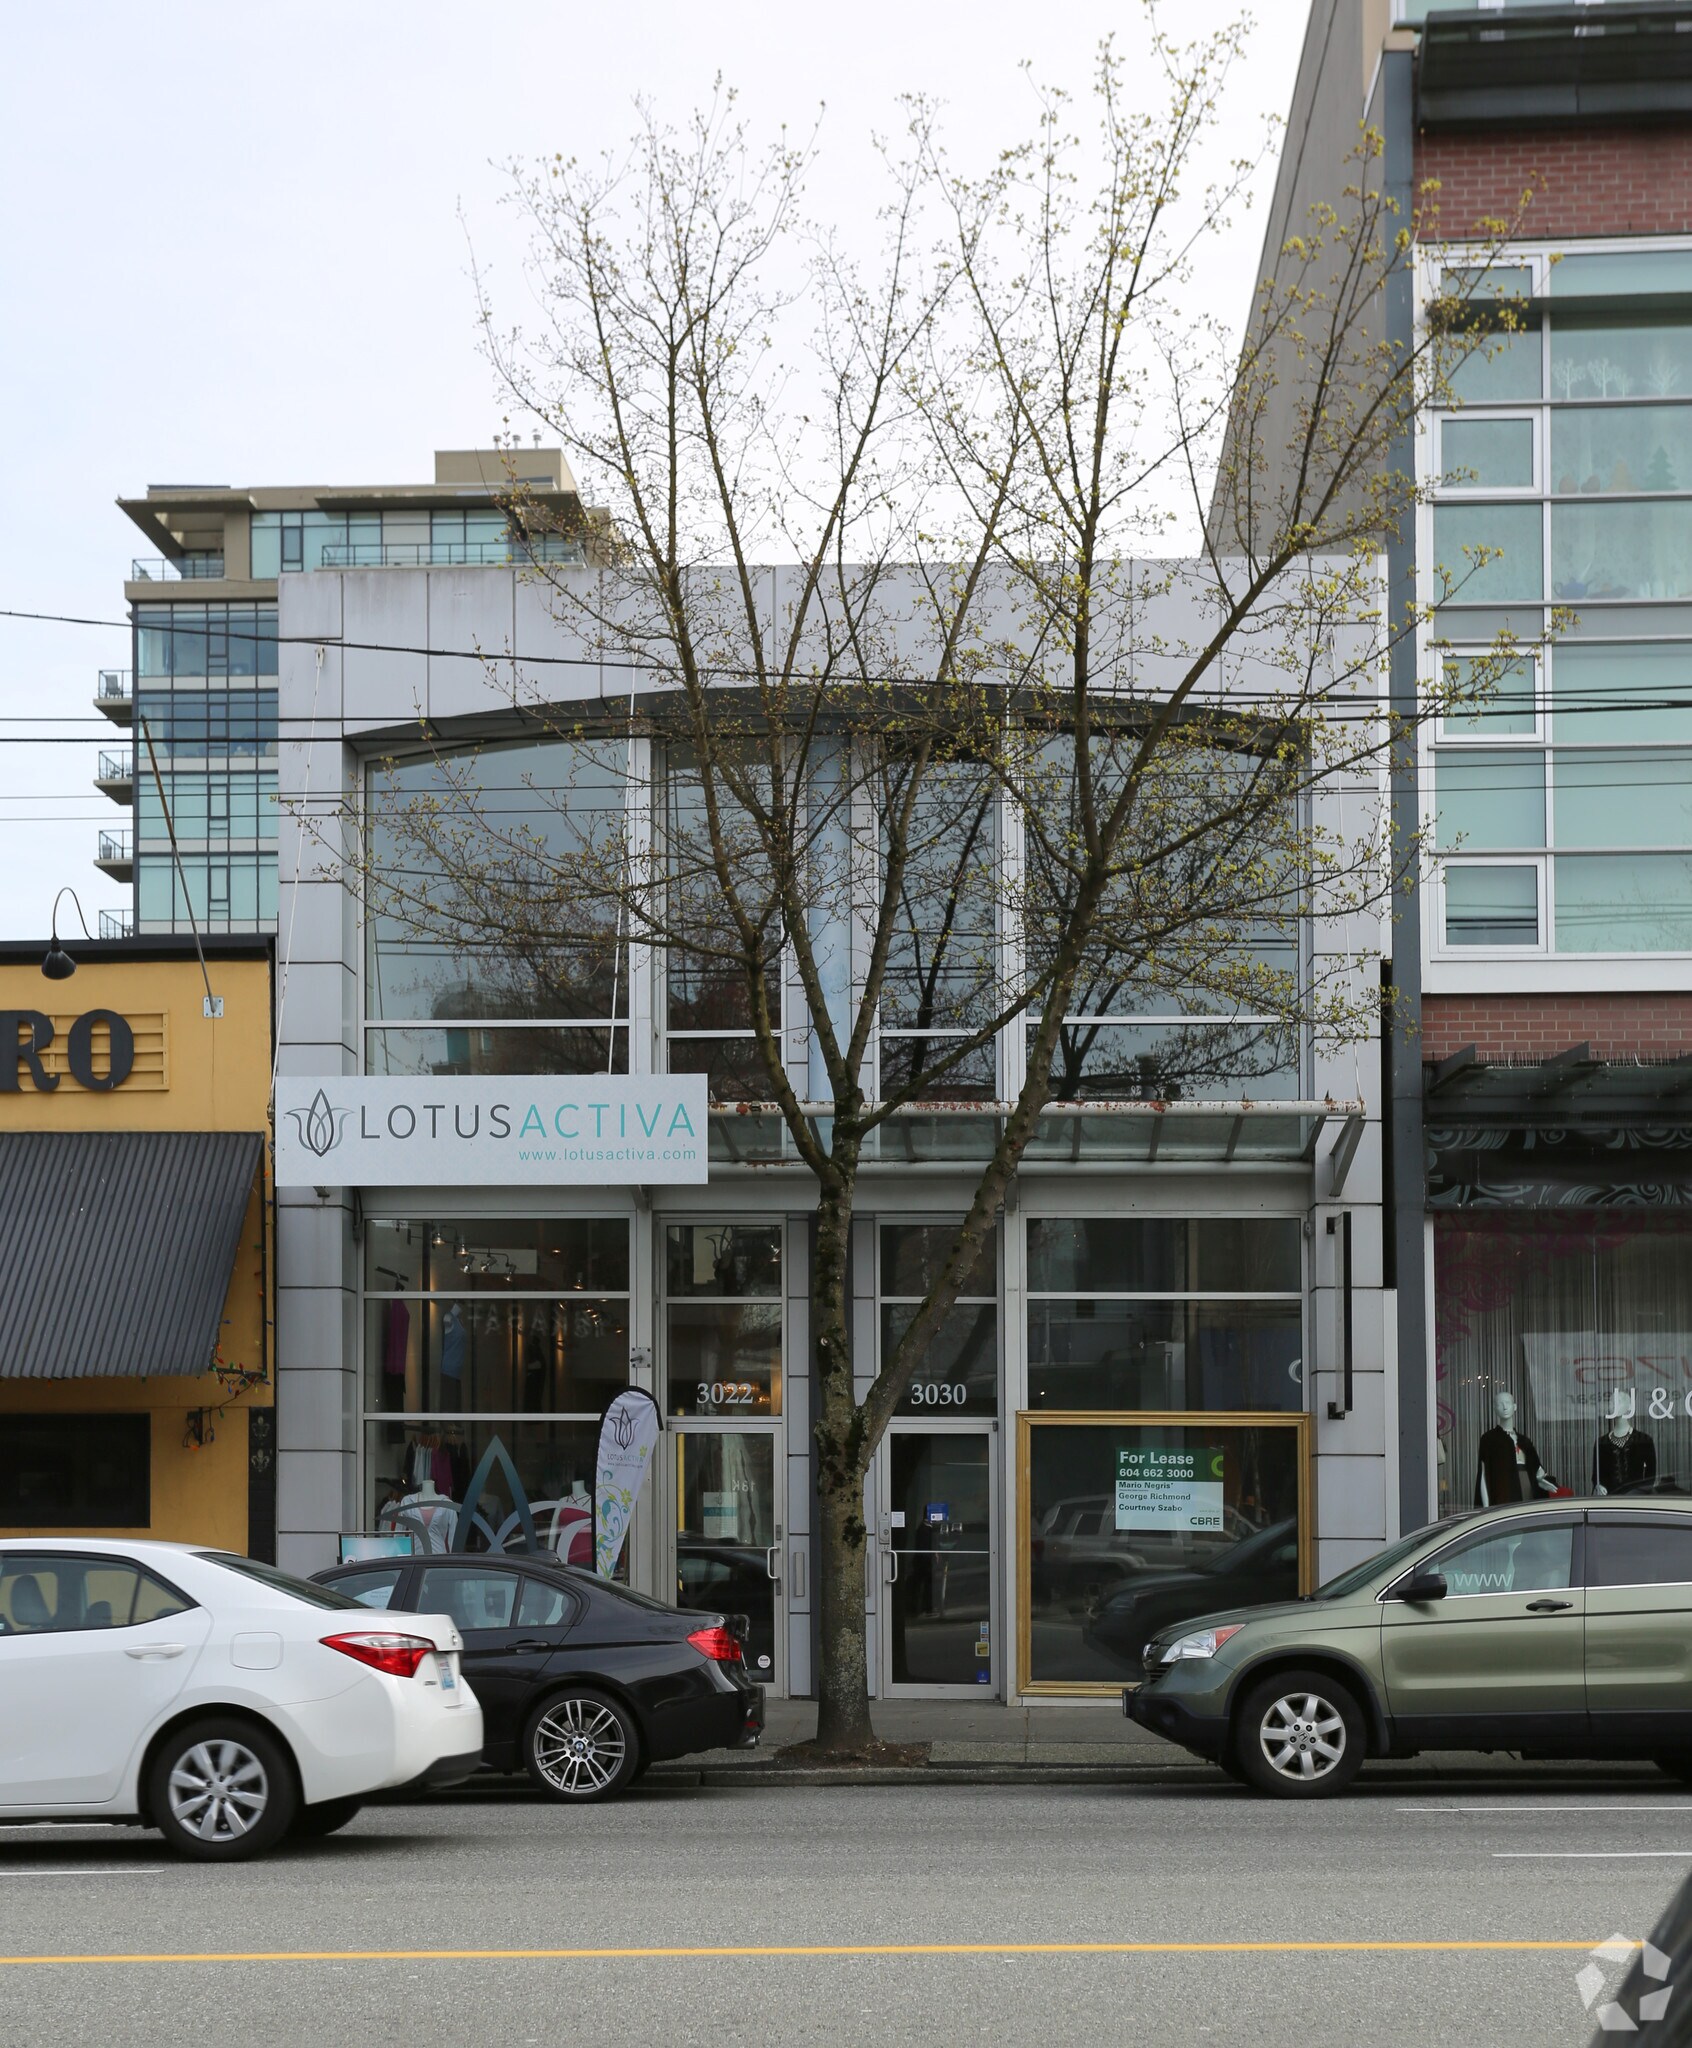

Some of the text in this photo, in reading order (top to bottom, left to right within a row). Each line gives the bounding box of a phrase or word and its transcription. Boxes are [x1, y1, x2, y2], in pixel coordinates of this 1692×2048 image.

[519, 1147, 696, 1161] www.lotusactiva.com
[696, 1382, 754, 1404] 3022
[911, 1383, 967, 1405] 3030
[1605, 1388, 1636, 1419] JJ
[1649, 1387, 1674, 1419] &
[1120, 1451, 1194, 1465] For Lease
[1119, 1468, 1194, 1478] 604 662 3000
[1118, 1493, 1191, 1501] George Richmond
[1118, 1504, 1183, 1512] Courtney Szabo
[1190, 1517, 1220, 1525] CBRE
[1454, 1573, 1512, 1587] www
